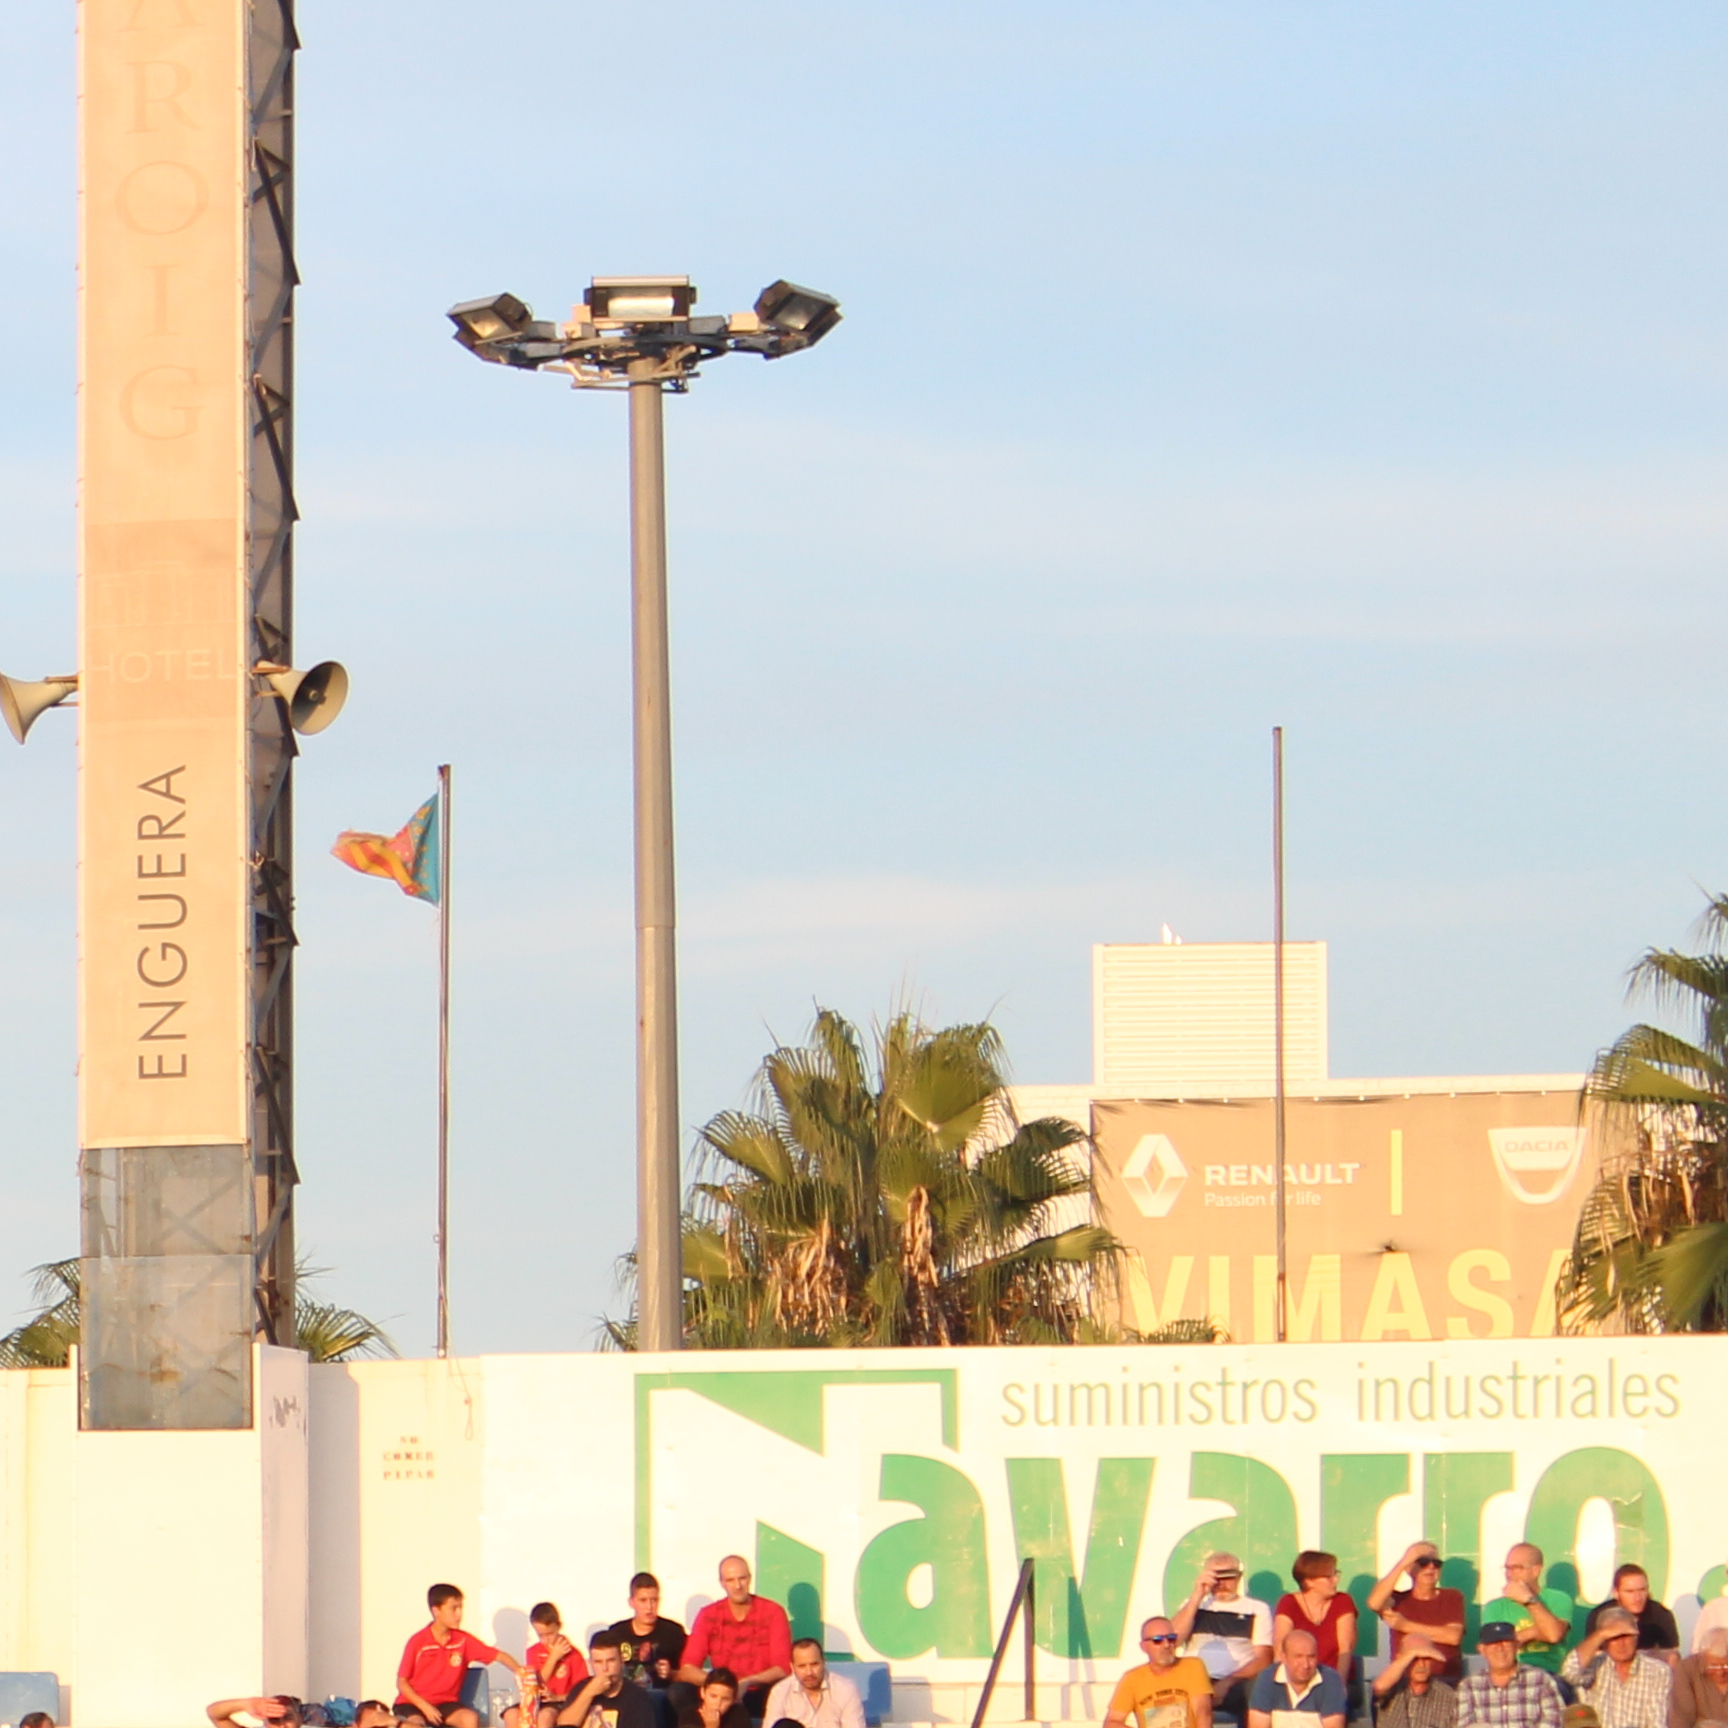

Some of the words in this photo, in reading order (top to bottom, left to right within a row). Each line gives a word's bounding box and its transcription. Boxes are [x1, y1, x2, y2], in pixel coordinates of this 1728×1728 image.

[87, 648, 236, 684] HOTEL
[137, 764, 187, 1081] ENGUERA
[1505, 1140, 1569, 1153] DACIA
[1204, 1162, 1361, 1187] RENAULT
[1204, 1192, 1266, 1208] Passion
[1270, 1191, 1294, 1207] fr
[1296, 1190, 1322, 1206] life
[1001, 1366, 1319, 1427] suministros
[1357, 1357, 1681, 1421] industriales
[400, 1435, 419, 1445] NO
[382, 1450, 435, 1462] COMER
